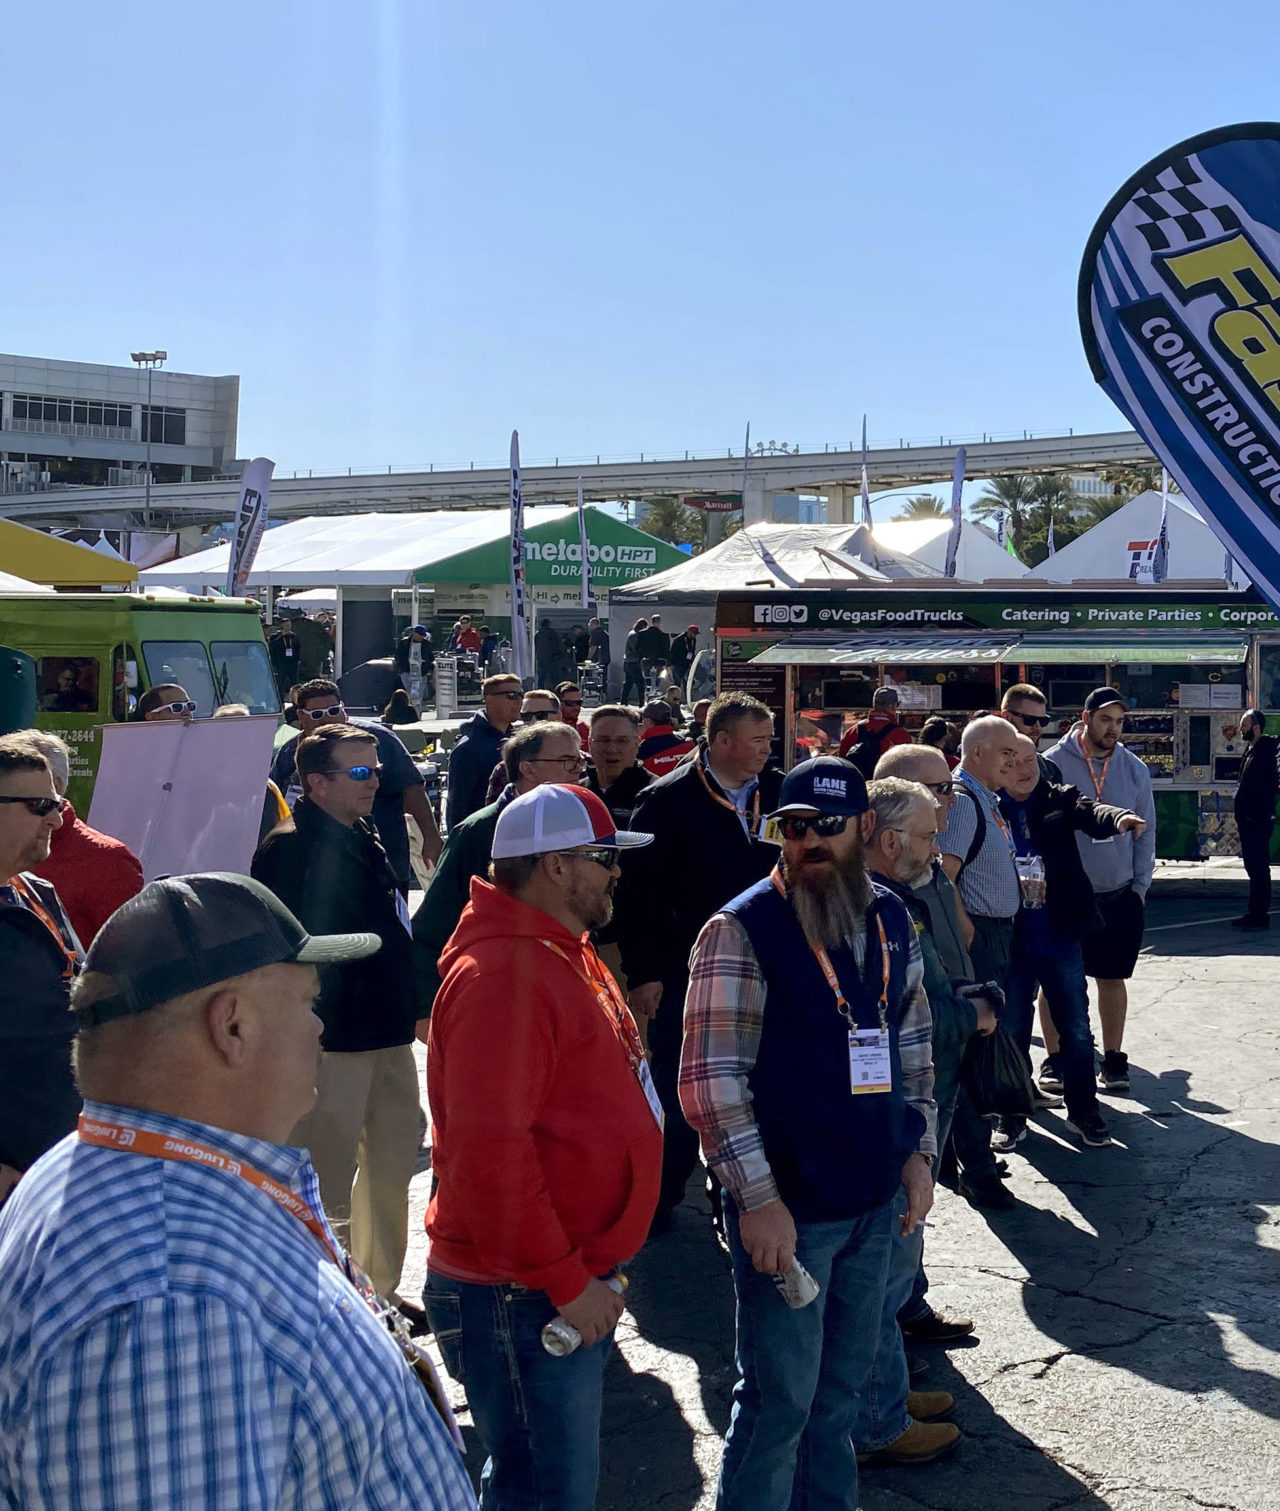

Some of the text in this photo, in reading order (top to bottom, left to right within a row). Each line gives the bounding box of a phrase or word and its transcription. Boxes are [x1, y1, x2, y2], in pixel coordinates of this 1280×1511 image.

[704, 501, 732, 509] Marriott
[524, 539, 653, 562] metabo HPT
[551, 565, 655, 578] DURAILITY FIRST
[1135, 563, 1152, 574] CREA
[818, 609, 963, 623] @VegasFoodTrucks
[1001, 608, 1070, 623] Catering
[1088, 609, 1144, 621] Private
[1148, 609, 1202, 621] Parties
[814, 777, 847, 791] LANE
